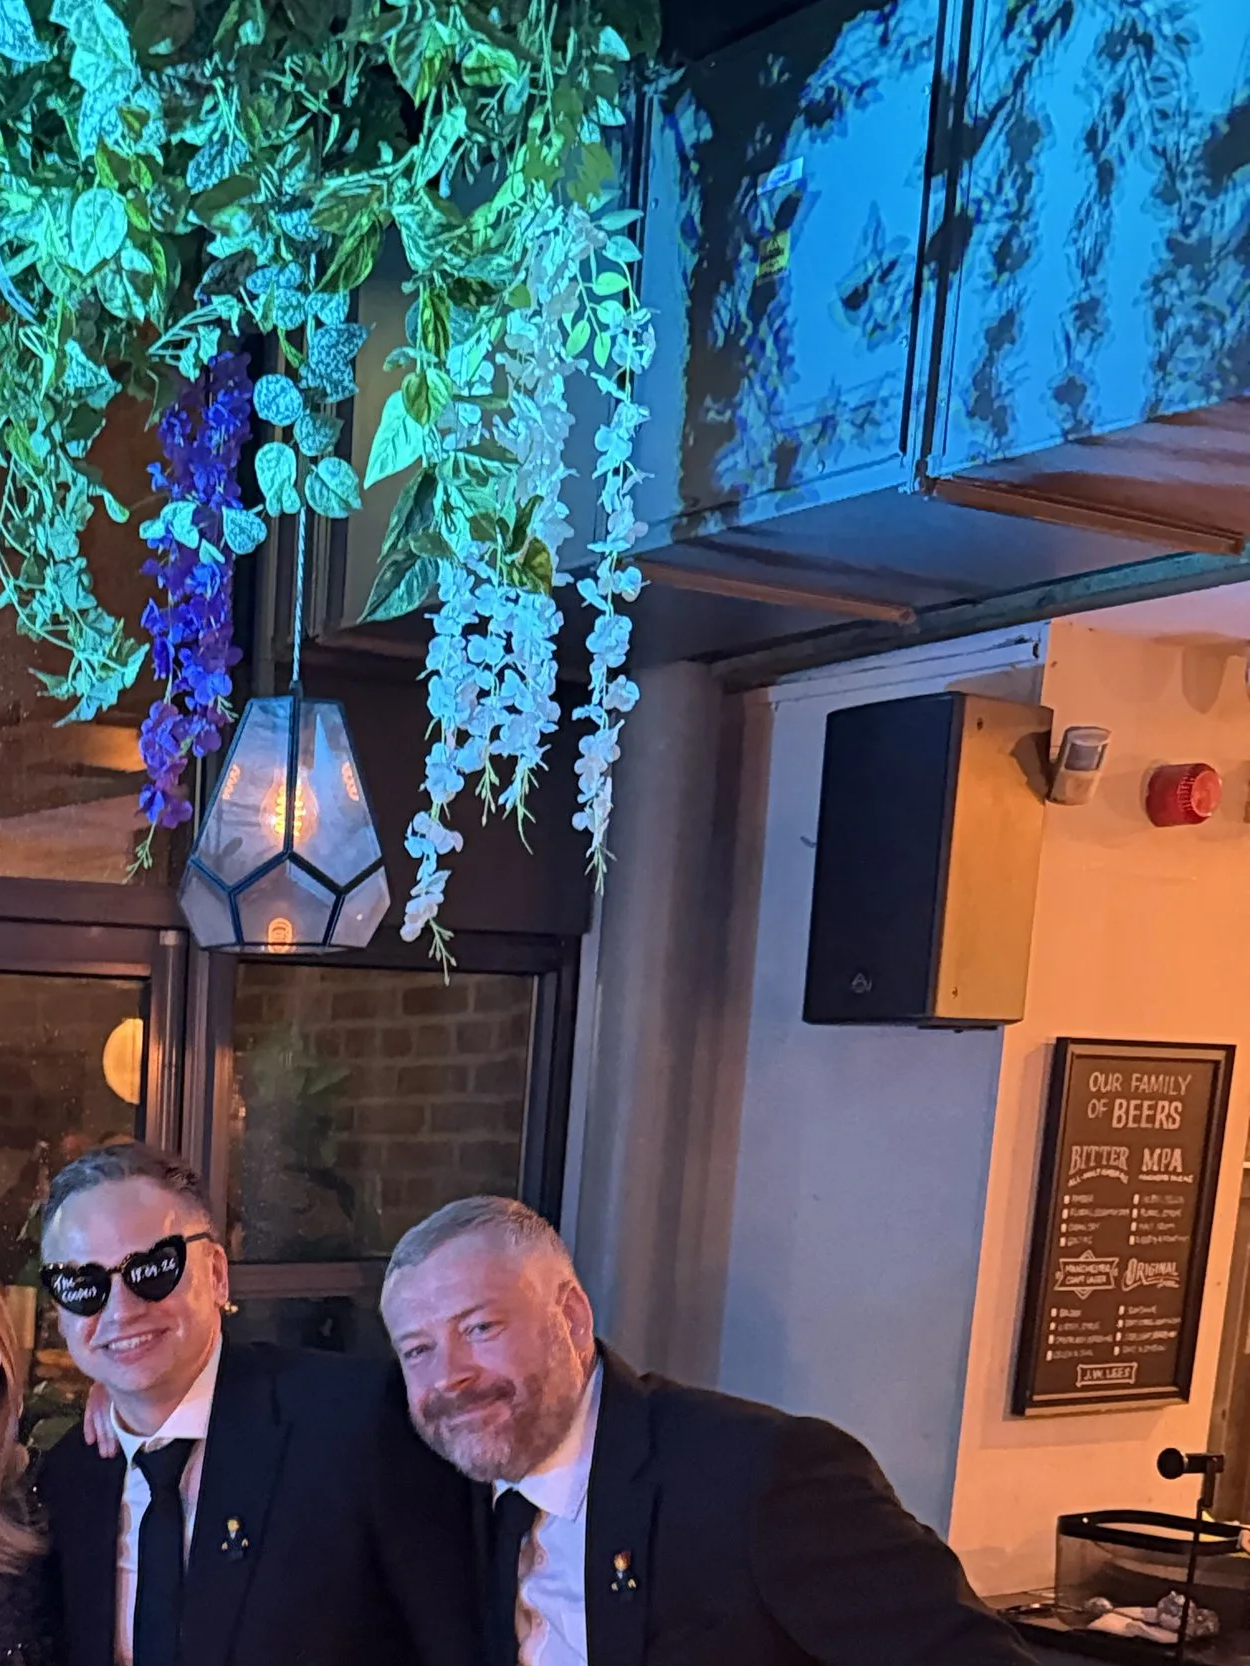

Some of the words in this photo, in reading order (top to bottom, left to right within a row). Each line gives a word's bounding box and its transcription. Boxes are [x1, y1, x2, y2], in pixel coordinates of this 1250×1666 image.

[1089, 1071, 1123, 1093] OUR
[1130, 1073, 1192, 1096] FAMILY
[1087, 1099, 1109, 1119] OF
[1111, 1098, 1183, 1130] BEERS
[1068, 1145, 1130, 1175] BITTER
[1141, 1147, 1183, 1173] MPA
[1123, 1258, 1179, 1289] ORIGINAL
